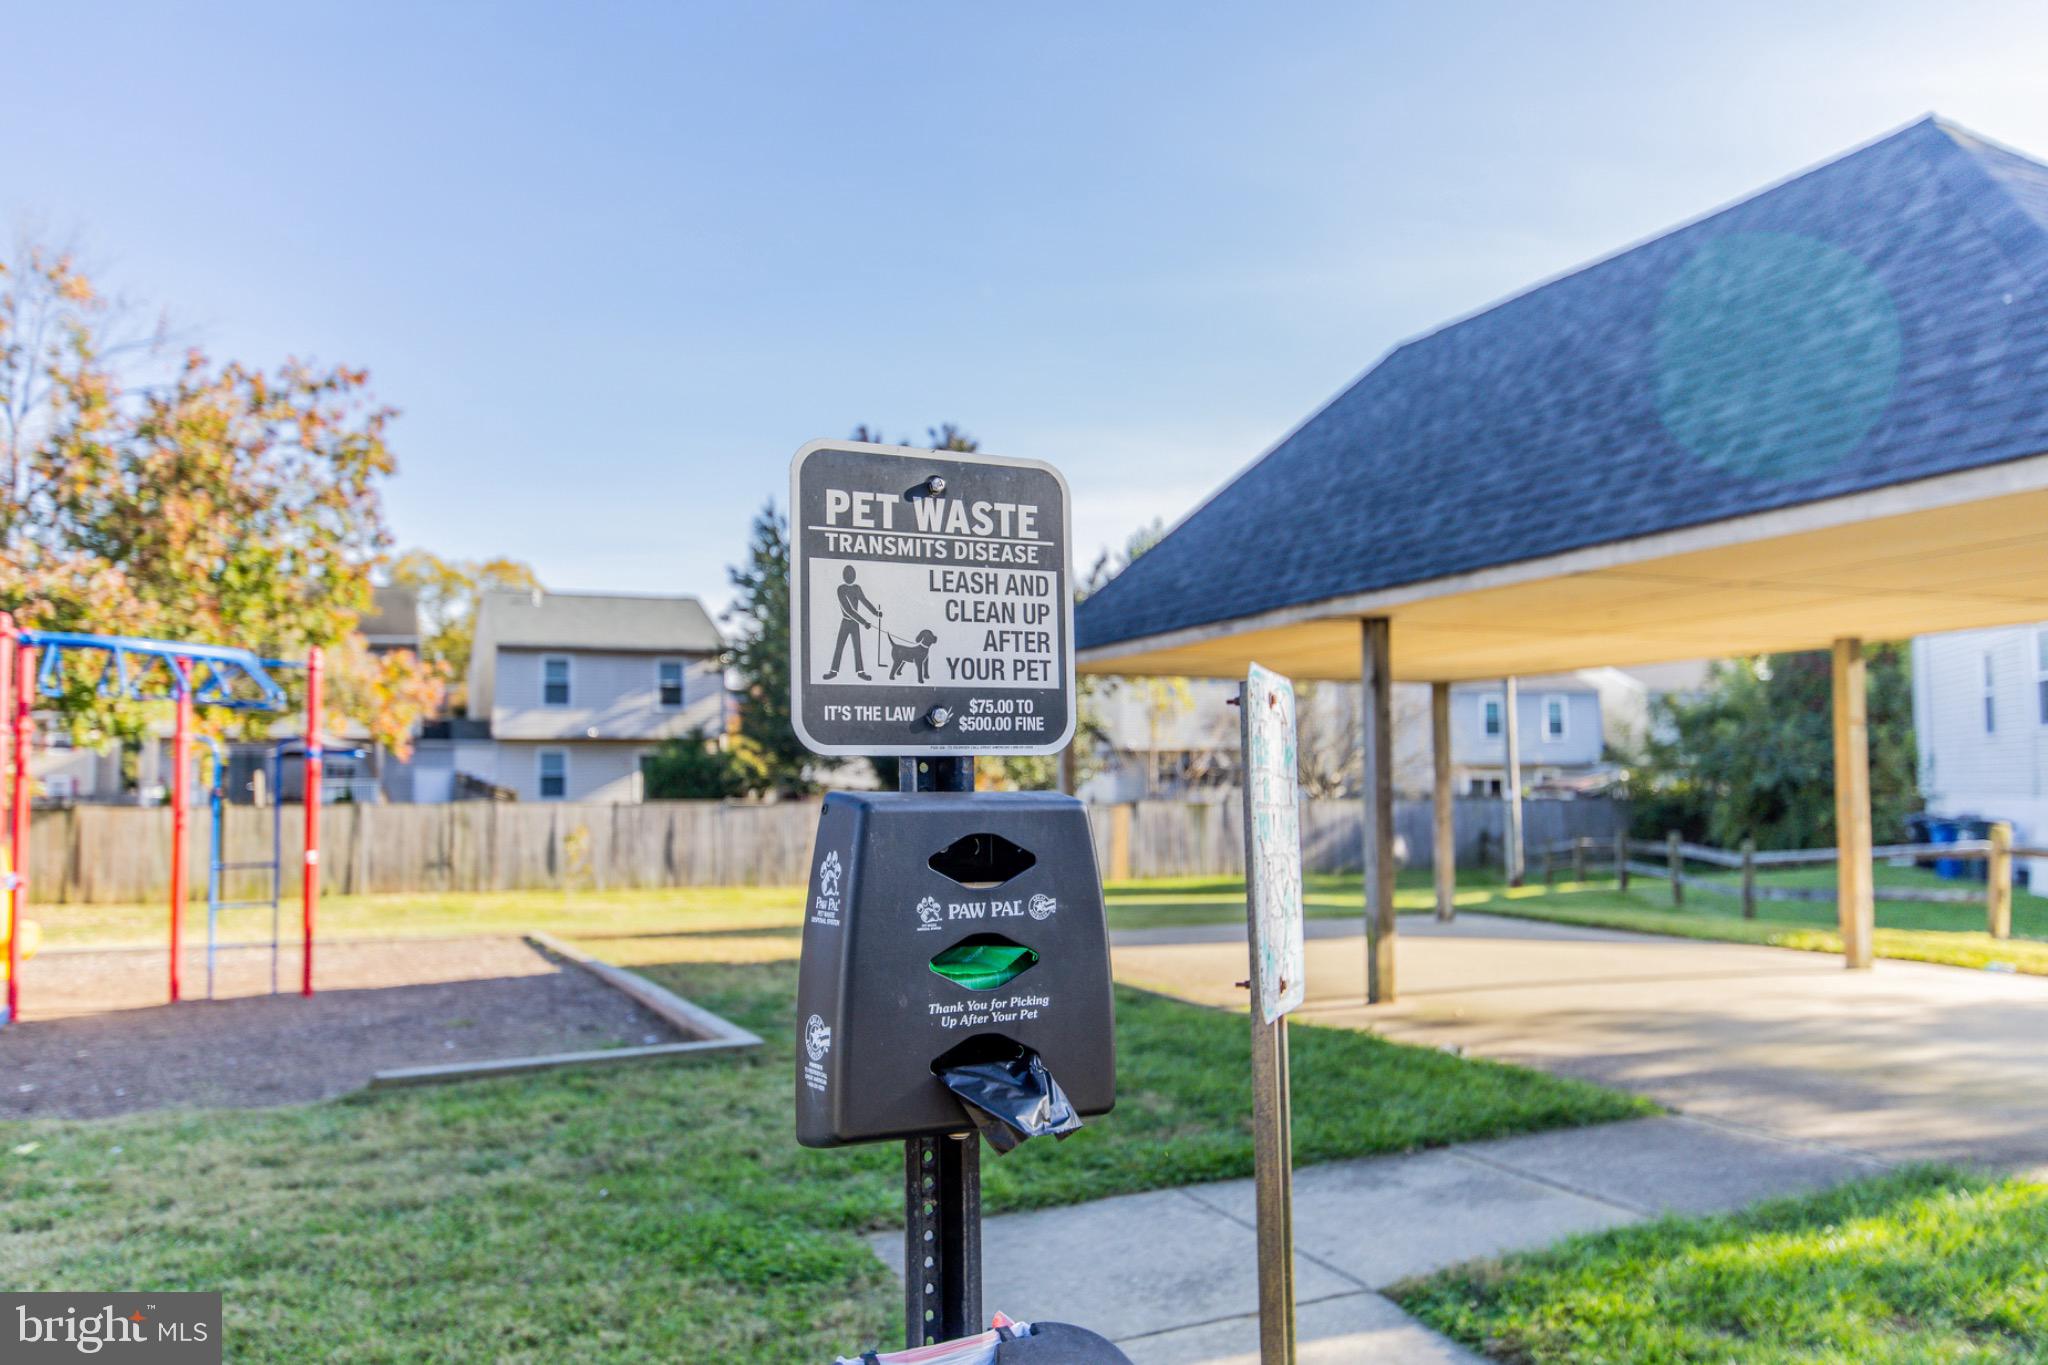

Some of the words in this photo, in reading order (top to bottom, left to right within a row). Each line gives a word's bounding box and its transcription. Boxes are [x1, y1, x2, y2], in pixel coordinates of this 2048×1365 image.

[825, 488, 899, 529] PET
[912, 496, 1039, 539] WASTE
[824, 532, 948, 559] TRANSMITS
[954, 546, 1040, 564] DISEASE
[929, 569, 999, 595] LEASH
[1004, 573, 1049, 597] AND
[945, 599, 1016, 624] CLEAN
[1022, 602, 1050, 625] UP
[983, 629, 1051, 653] AFTER
[945, 657, 1005, 681] YOUR
[1012, 659, 1052, 682] PET
[824, 705, 852, 722] IT'S
[854, 705, 882, 721] THE
[885, 706, 916, 722] LAW
[969, 698, 1014, 715] $75.00
[1016, 699, 1034, 715] TO
[958, 715, 1013, 733] $500.00
[1014, 716, 1045, 732] FINE
[948, 902, 986, 920] PAW
[990, 900, 1025, 918] PAL
[928, 1001, 964, 1015] Thank
[966, 1000, 988, 1012] You
[989, 998, 1008, 1011] for
[1010, 995, 1050, 1008] Picking
[941, 1015, 957, 1029] Up
[959, 1013, 989, 1027] After
[991, 1011, 1018, 1023] Your
[1020, 1008, 1038, 1020] Pet
